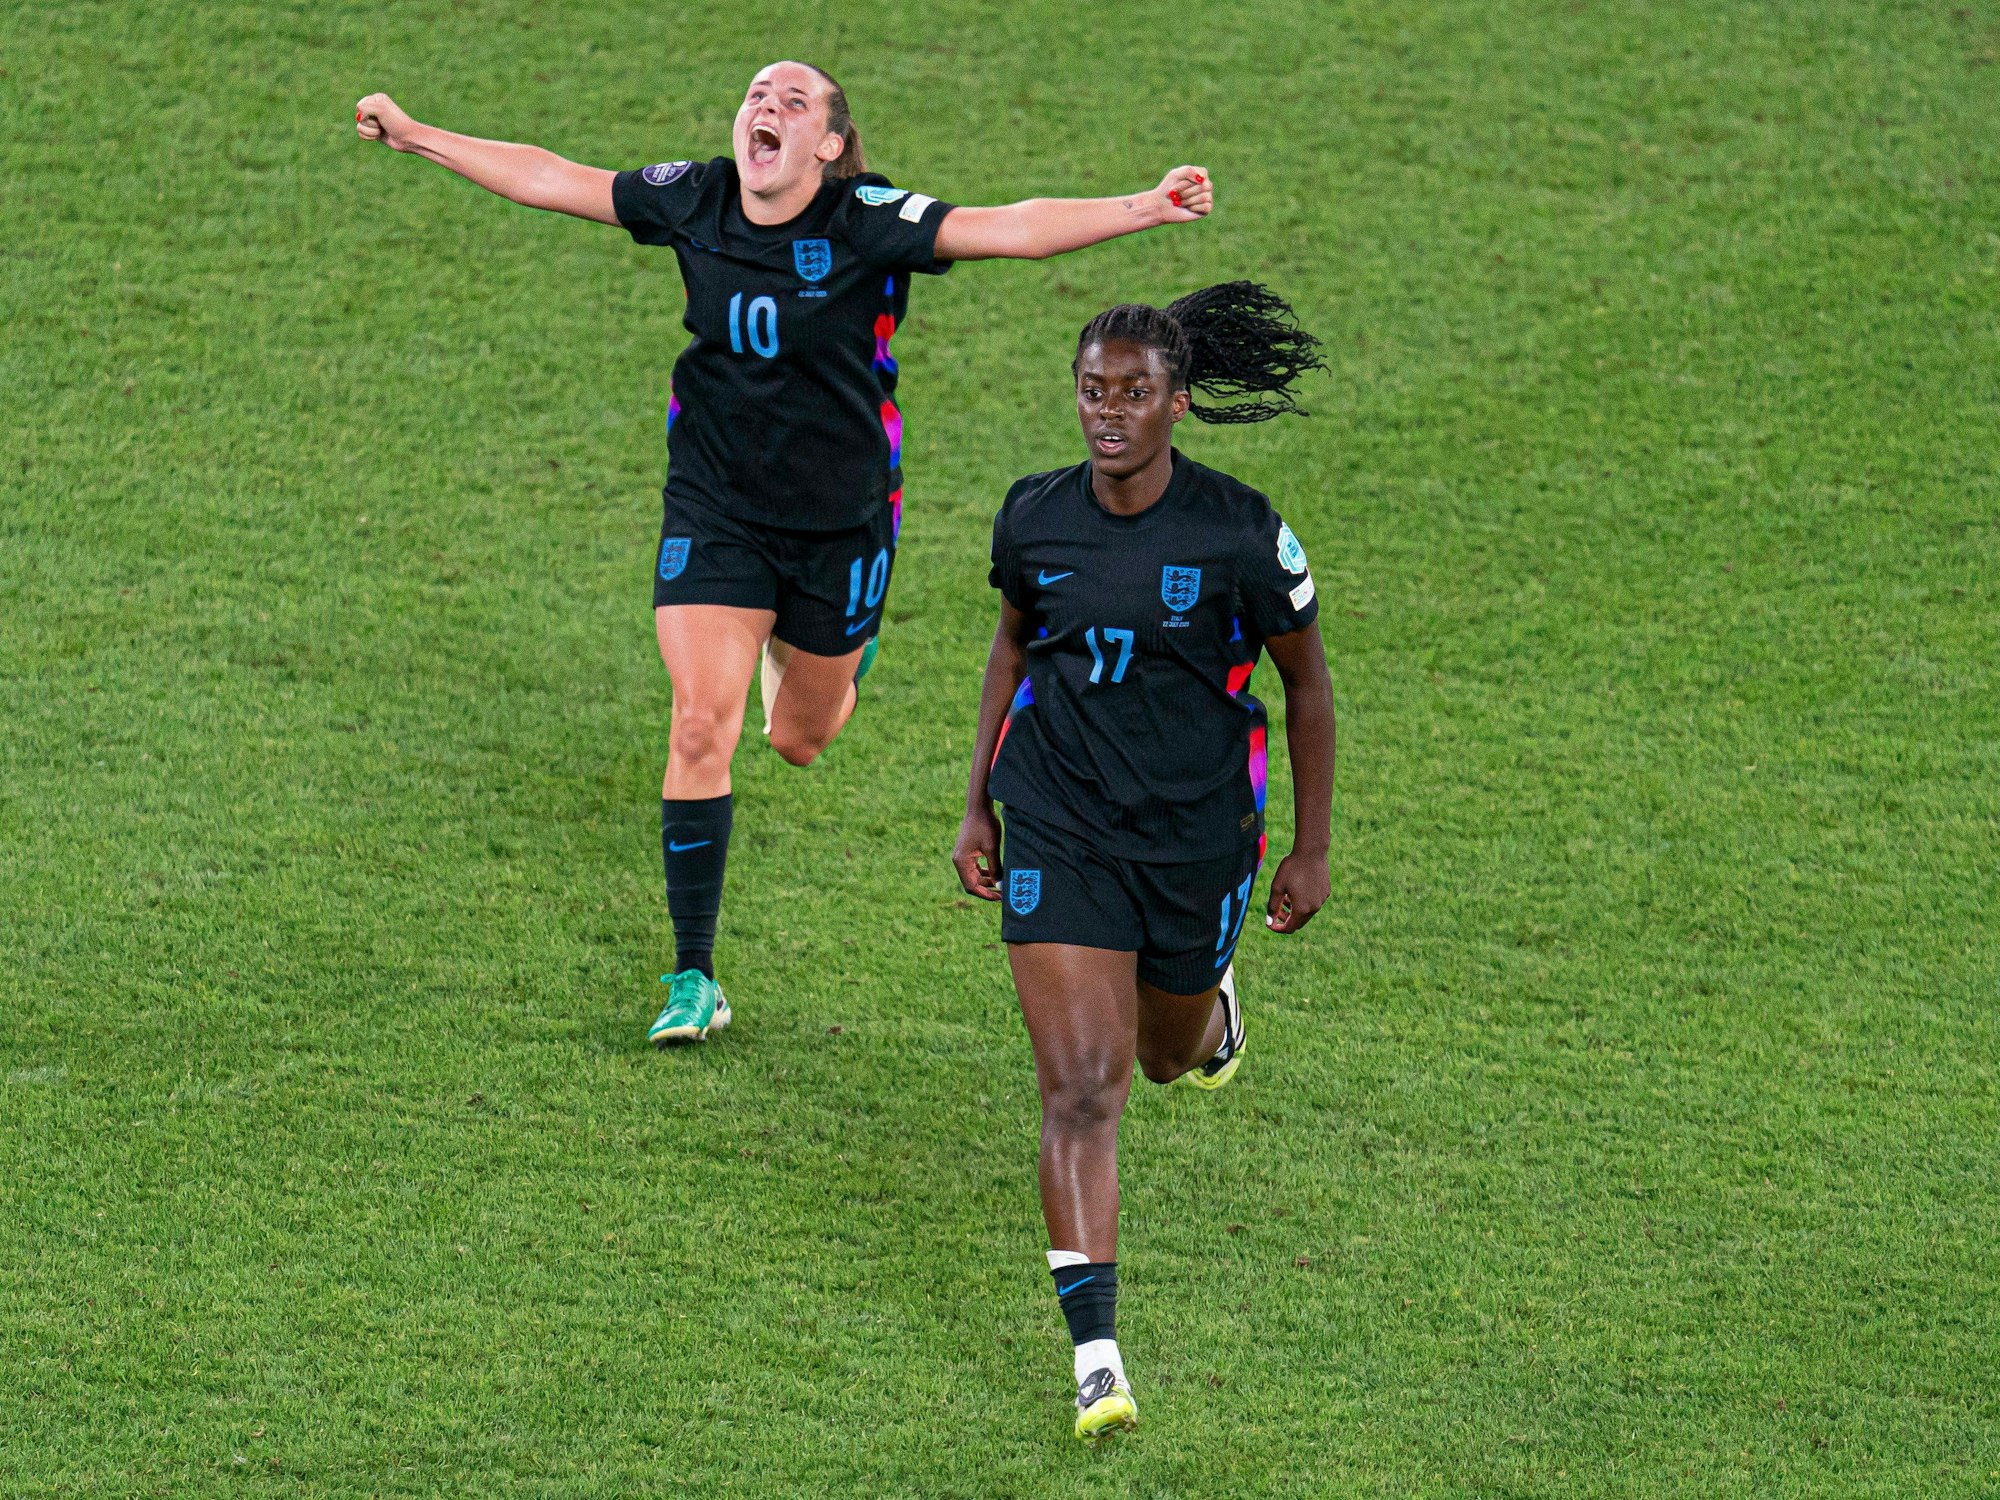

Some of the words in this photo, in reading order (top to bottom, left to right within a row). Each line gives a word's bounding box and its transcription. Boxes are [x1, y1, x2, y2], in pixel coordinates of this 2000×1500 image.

[728, 291, 780, 359] 10
[845, 547, 889, 617] 10
[1084, 626, 1135, 684] 17
[1215, 872, 1252, 951] 17
